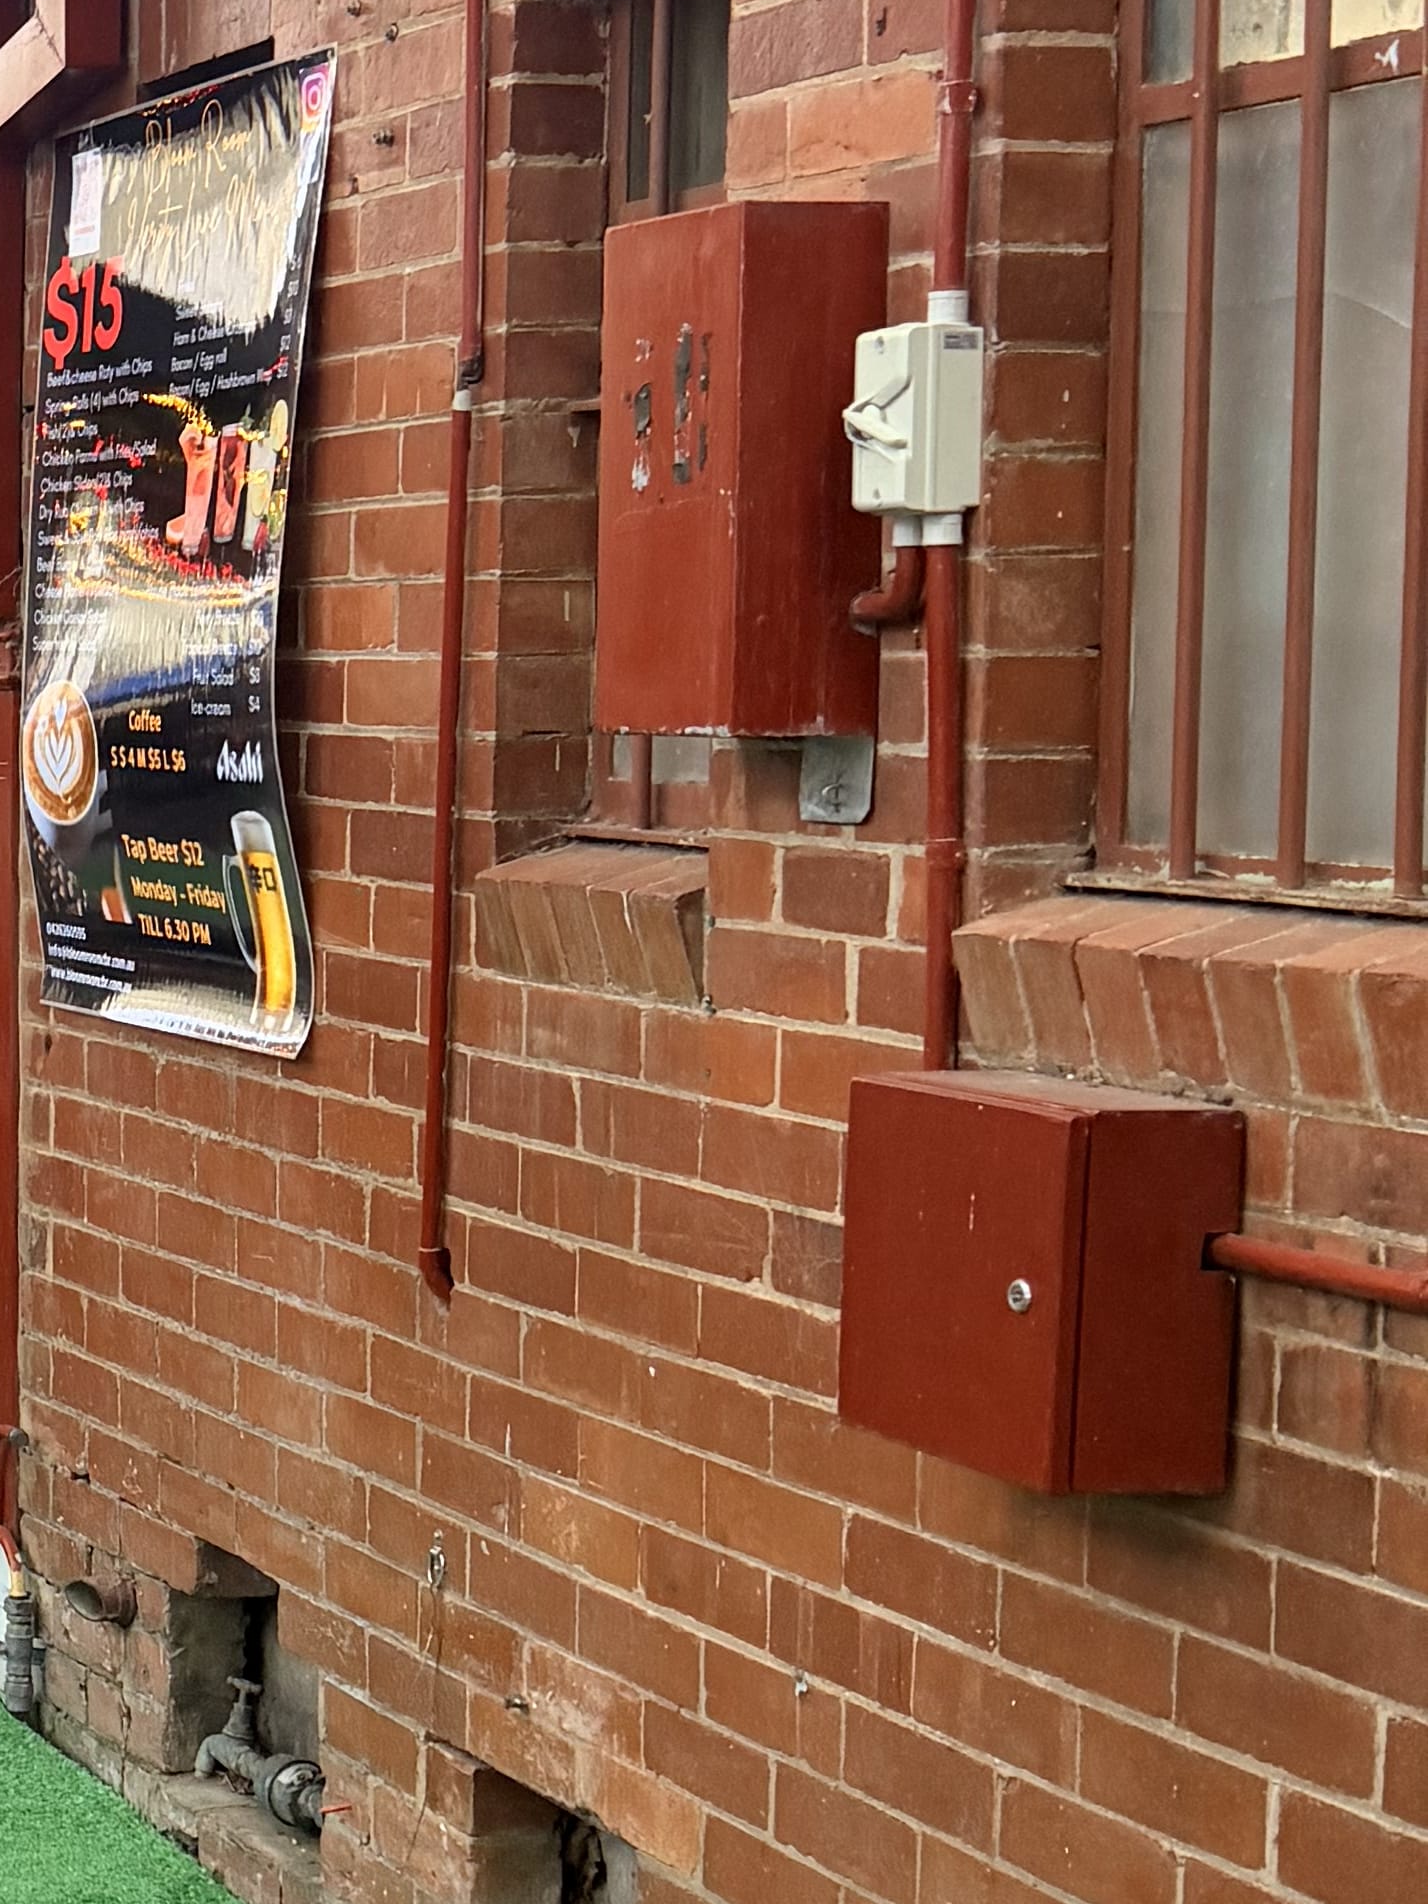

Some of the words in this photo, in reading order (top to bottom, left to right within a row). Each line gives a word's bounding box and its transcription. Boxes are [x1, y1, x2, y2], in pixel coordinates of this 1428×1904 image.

[43, 255, 124, 371] $15
[132, 357, 153, 377] Chips
[118, 387, 140, 408] Chips
[128, 709, 162, 733] Coffee
[216, 738, 264, 784] Asahi
[121, 834, 147, 864] Tap
[147, 837, 178, 863] Beer
[181, 838, 205, 867] $12
[130, 876, 178, 907] Monday
[186, 882, 226, 915] Friday
[164, 918, 191, 942] 6.30
[191, 922, 212, 947] PM
